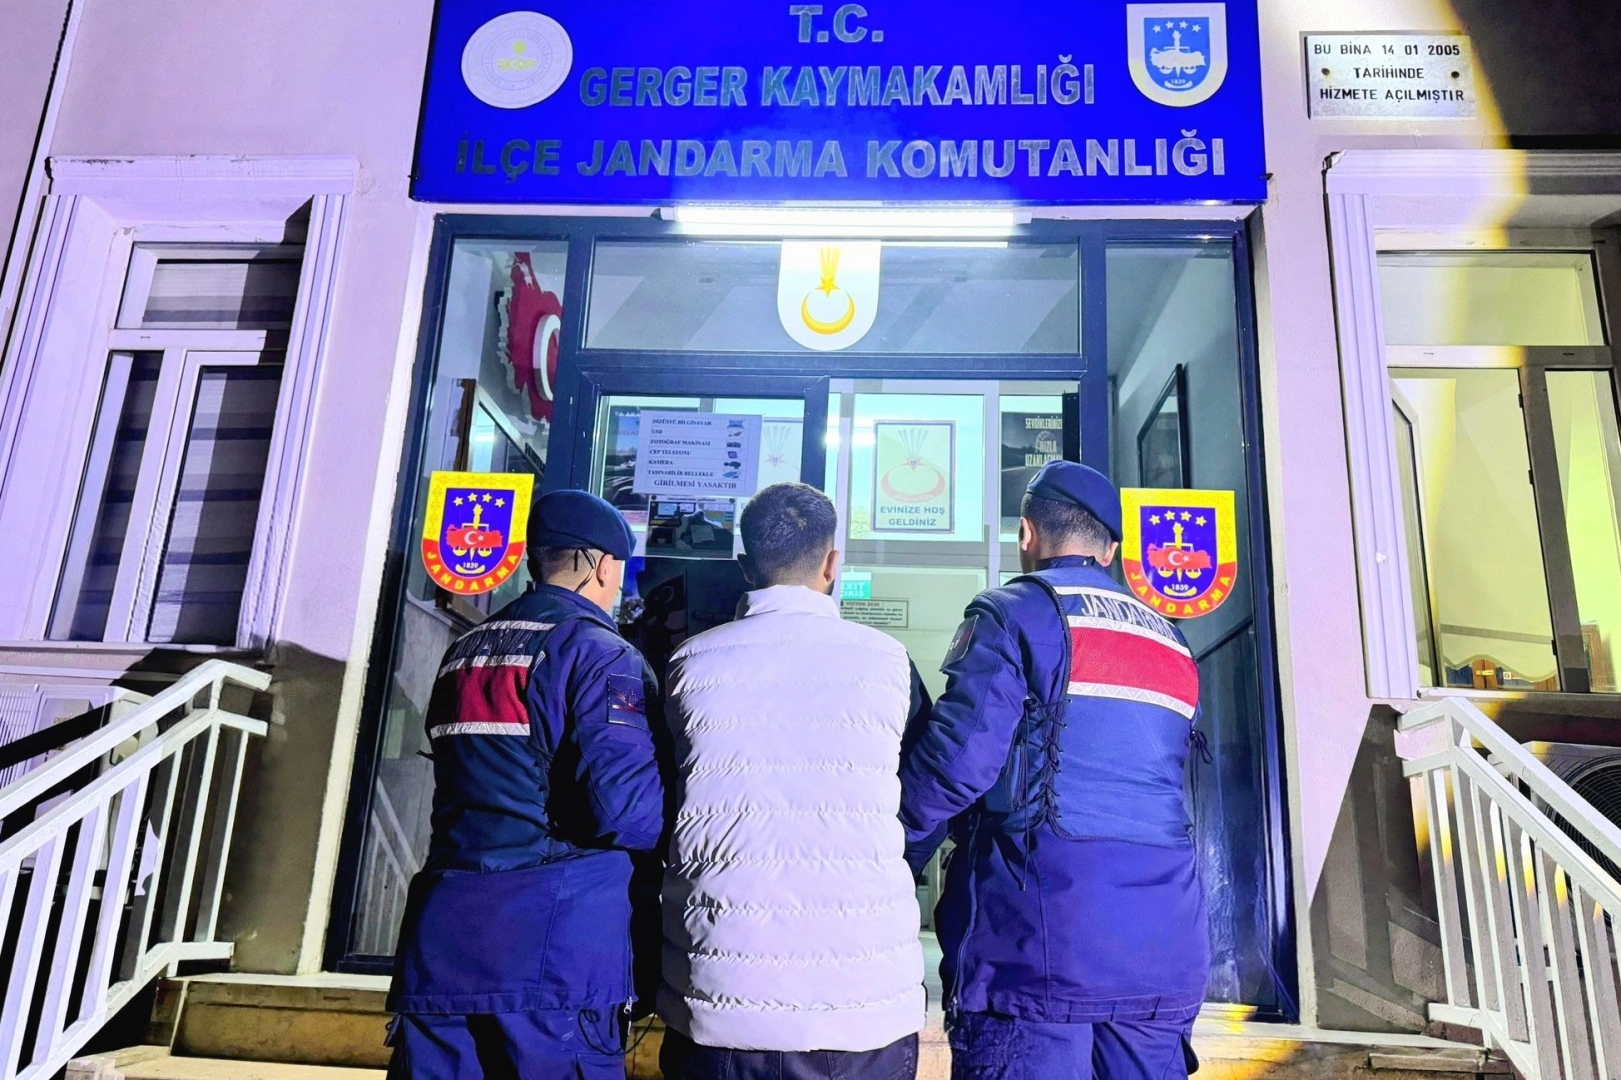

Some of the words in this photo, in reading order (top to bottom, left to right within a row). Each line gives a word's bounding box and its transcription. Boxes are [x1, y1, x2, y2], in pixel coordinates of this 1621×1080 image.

[790, 4, 884, 43] T.C.
[1314, 44, 1331, 55] BU
[1340, 41, 1372, 55] BİNA
[1382, 45, 1395, 55] 14
[1404, 44, 1419, 56] 01
[1428, 44, 1461, 56] 2005
[579, 66, 748, 107] GERGER
[761, 54, 1095, 107] KAYMAKAMLIĞI
[1320, 86, 1377, 100] HİZMETE
[1385, 89, 1465, 103] AÇILMIŞTIR
[456, 131, 562, 184] İLÇE
[577, 139, 849, 178] JANDARMA
[866, 129, 1226, 178] KOMUTANLIĞI
[653, 479, 695, 487] GİRİLMESİ
[880, 505, 921, 514] EVİNİZE
[924, 506, 945, 516] HOŞ
[888, 517, 937, 526] GELDİNİZ
[427, 552, 518, 591] JANDARMA
[840, 582, 865, 590] EXIT
[1130, 572, 1231, 615] JANDARMA
[1081, 594, 1180, 644] JANDARMA
